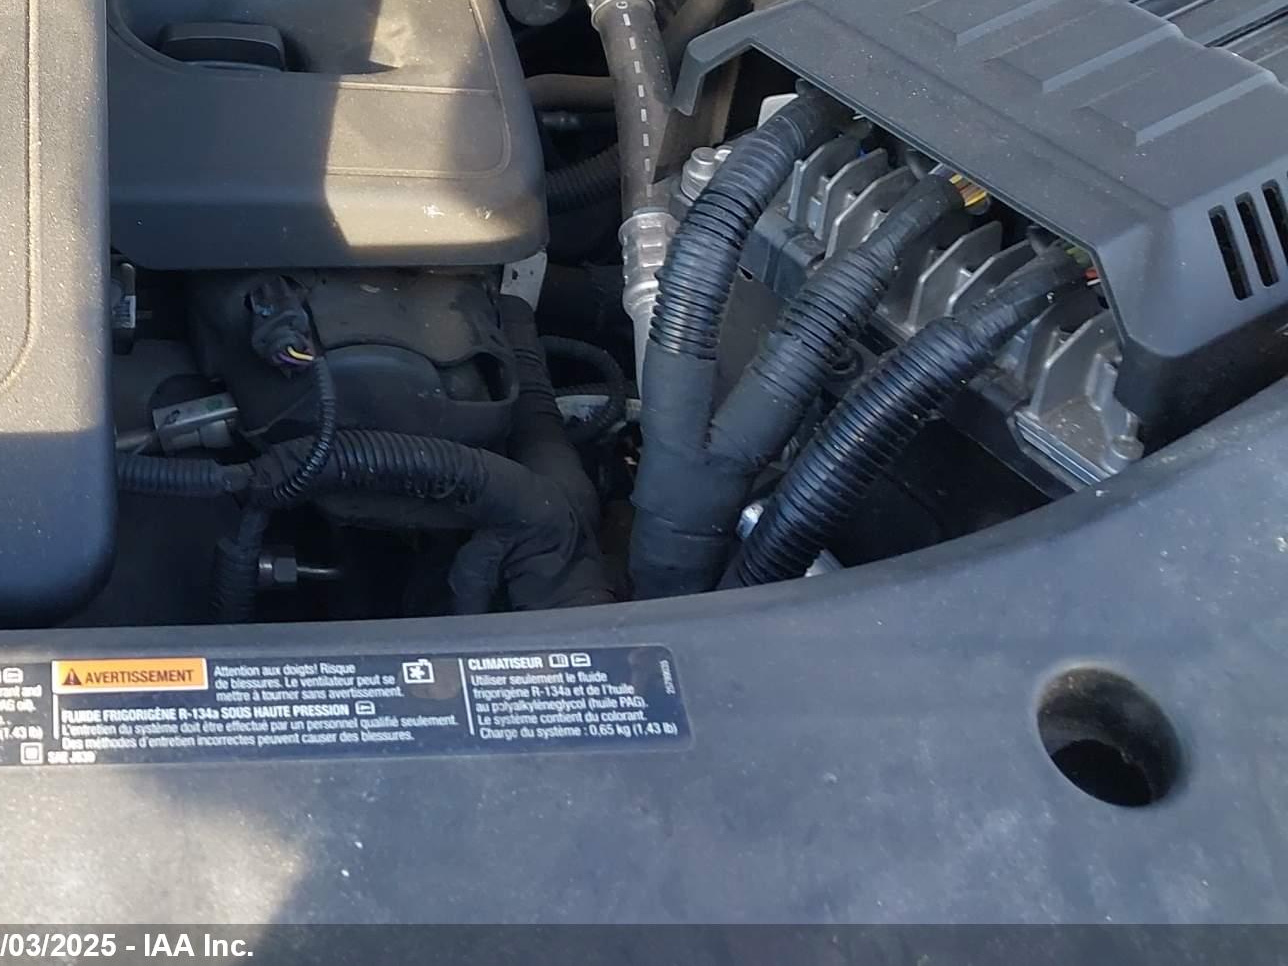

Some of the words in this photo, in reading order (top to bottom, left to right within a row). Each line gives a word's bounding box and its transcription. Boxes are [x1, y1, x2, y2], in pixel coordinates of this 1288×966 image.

[214, 665, 260, 677] Attention
[262, 666, 281, 675] aux
[283, 663, 318, 677] doigts!
[320, 662, 355, 675] Risque
[468, 656, 544, 671] CLIMATISEUR
[85, 669, 194, 683] AVERTISSEMENT
[215, 678, 228, 689] de
[230, 676, 282, 689] blessures.
[285, 677, 299, 688] Le
[300, 676, 354, 687] ventilateur
[356, 675, 380, 687] peut
[382, 675, 395, 684] se
[471, 673, 507, 686] Utiliser
[509, 672, 564, 685] seulement
[565, 672, 576, 683] le
[578, 671, 608, 683] fluide
[216, 691, 250, 702] mettre
[252, 689, 260, 701] à
[262, 690, 299, 700] tourner
[301, 689, 327, 700] sans
[328, 686, 405, 699] avertissement.
[472, 688, 530, 701] frigorigène
[532, 686, 572, 698] R-134a
[574, 686, 585, 696] et
[587, 684, 601, 696] de
[602, 684, 635, 696] l'huile
[476, 703, 490, 713] au
[588, 697, 618, 711] (huile
[620, 696, 649, 708] PAG).
[62, 709, 102, 723] FLUIDE
[103, 706, 177, 721] FRIGORIGÈNE
[179, 708, 220, 720] R-134a
[221, 707, 253, 719] SOUS
[254, 705, 291, 718] HAUTE
[293, 704, 349, 717] PRESSION
[477, 714, 491, 725] Le
[493, 712, 538, 726] système
[540, 711, 583, 724] contient
[584, 711, 599, 722] du
[601, 710, 647, 722] colorant.
[62, 723, 116, 736] L'entretien
[118, 723, 133, 735] du
[134, 721, 179, 736] système
[180, 721, 201, 733] doit
[202, 720, 224, 733] être
[225, 718, 269, 732] effectué
[270, 721, 288, 733] par
[290, 720, 305, 731] un
[306, 718, 358, 732] personnel
[359, 716, 399, 731] qualifié
[400, 715, 460, 728] seulement.
[479, 726, 517, 741] Charge
[520, 725, 535, 738] du
[536, 724, 582, 739] système
[617, 724, 632, 737] kg
[663, 722, 678, 736] lb)
[62, 737, 83, 750] Des
[85, 736, 137, 749] méthodes
[139, 734, 195, 748] d'entretien
[197, 733, 255, 746] incorrectes
[258, 735, 300, 747] peuvent
[301, 733, 337, 744] causer
[339, 732, 358, 743] des
[361, 730, 415, 743] blessures.
